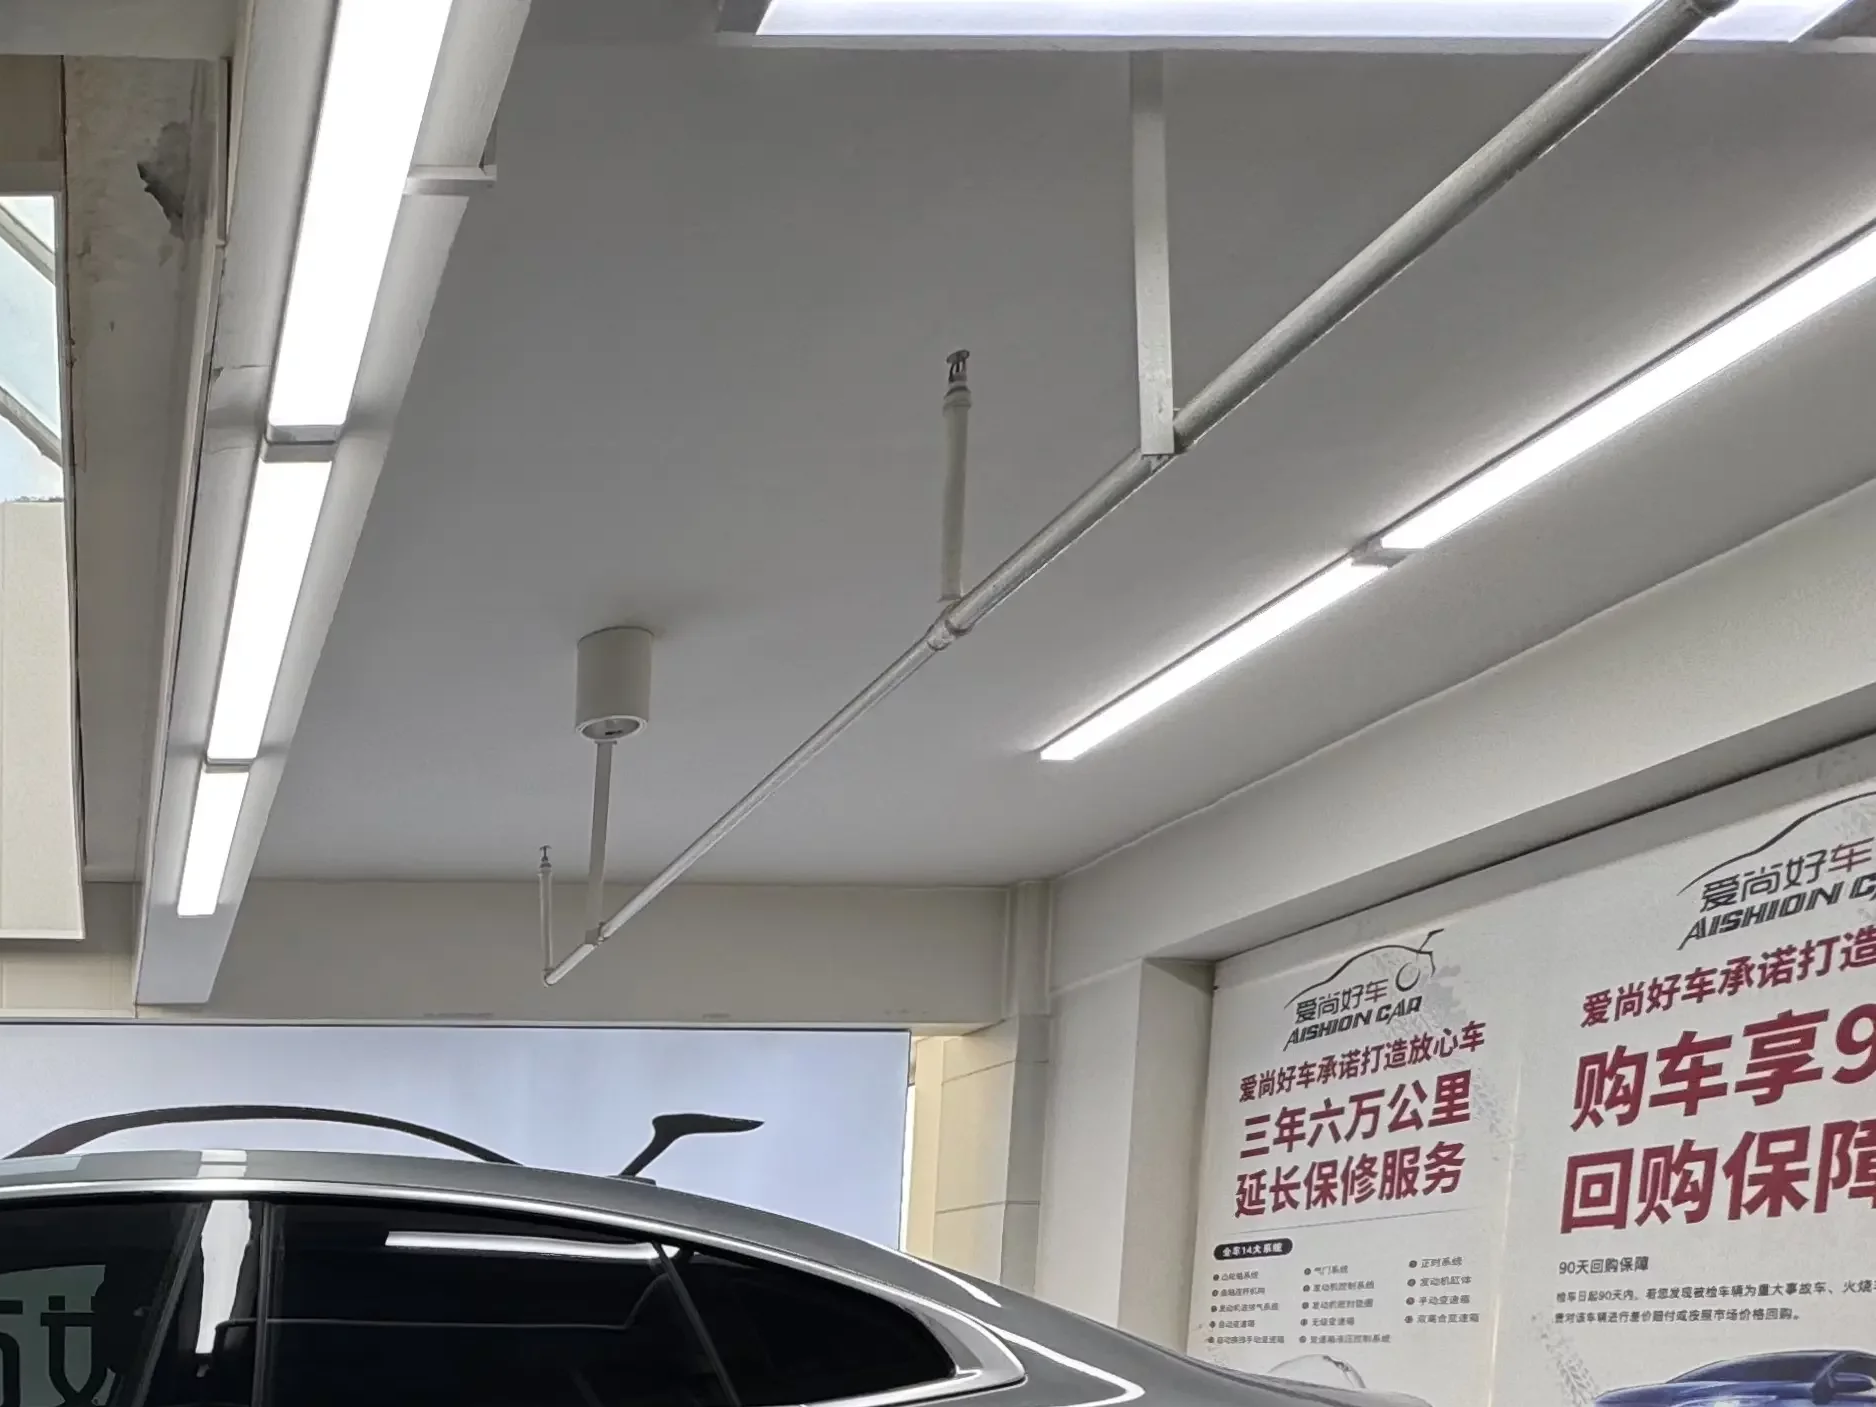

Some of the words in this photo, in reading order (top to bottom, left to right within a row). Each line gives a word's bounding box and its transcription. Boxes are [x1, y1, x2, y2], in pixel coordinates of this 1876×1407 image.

[1700, 838, 1876, 912] 爱尚好车
[1677, 881, 1844, 950] AISHION
[1295, 979, 1389, 1024] 爱尚好车
[1580, 924, 1876, 1028] 爱尚好车承诺打造
[1239, 1020, 1486, 1102] 爱尚好车承诺打造放心车
[1283, 1010, 1372, 1051] AISHION
[1375, 996, 1423, 1024] CAR
[1240, 1069, 1472, 1159] 三年六万公里
[1234, 1141, 1466, 1218] 延长保修服务
[1560, 1118, 1876, 1234] 回购保障
[1558, 1256, 1650, 1275] 90天回购保障
